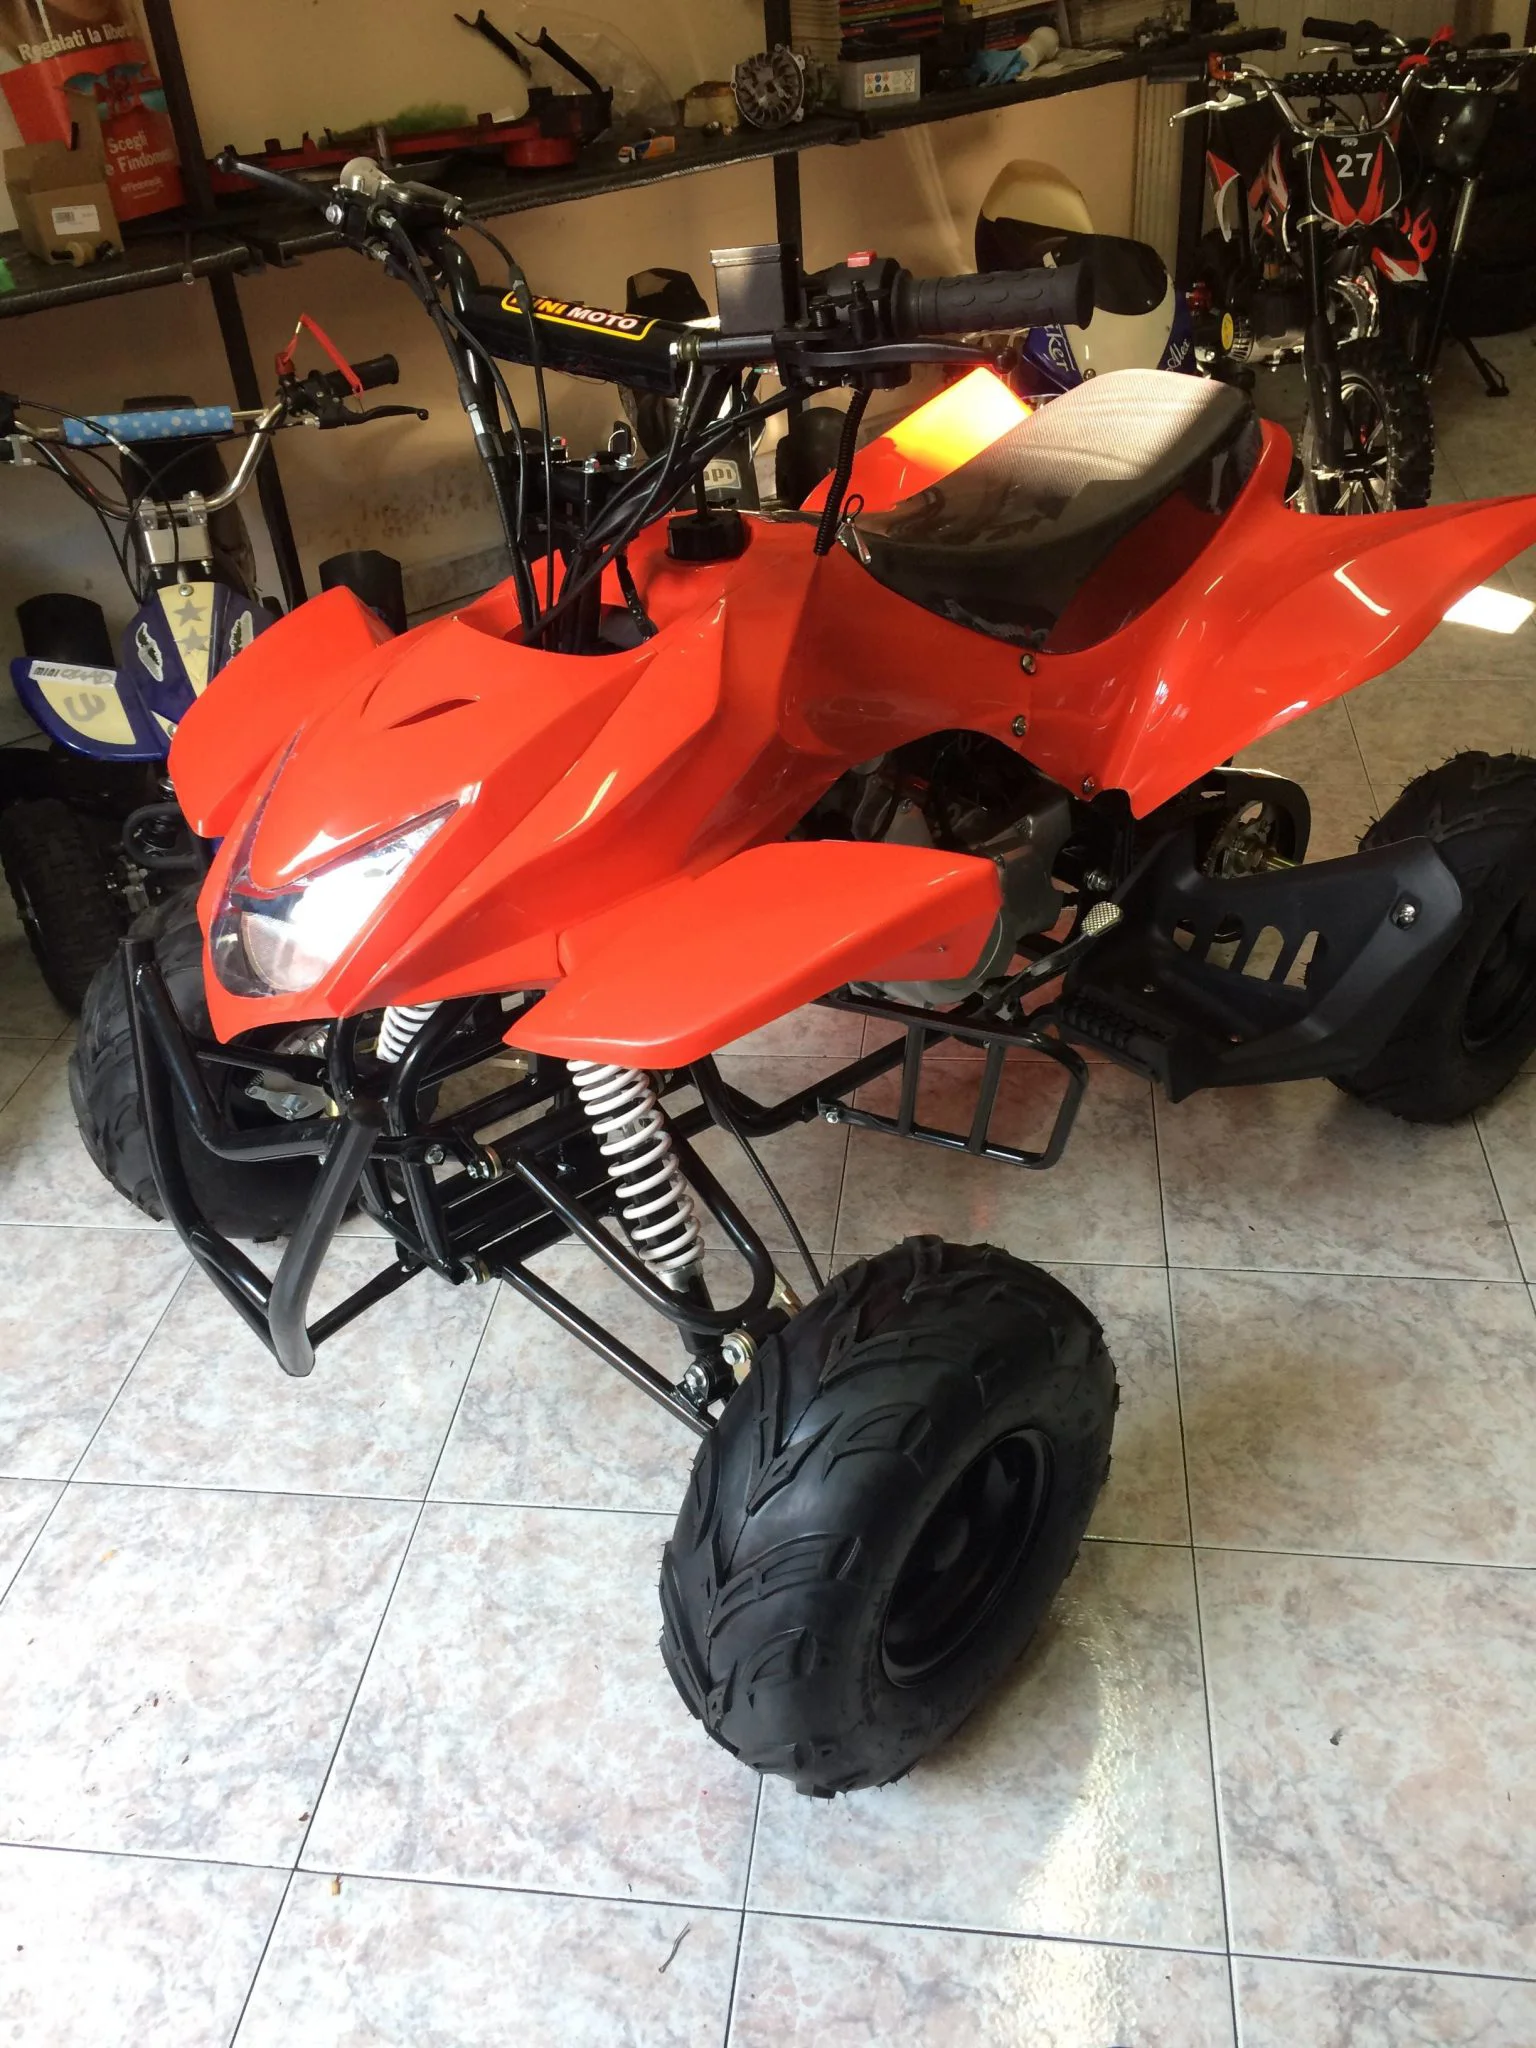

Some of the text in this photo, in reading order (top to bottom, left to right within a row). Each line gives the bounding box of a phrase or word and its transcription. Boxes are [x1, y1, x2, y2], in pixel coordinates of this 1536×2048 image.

[18, 30, 86, 61] Regalati
[87, 27, 103, 44] la
[107, 131, 149, 155] Scegli
[1335, 152, 1374, 178] 27
[510, 296, 638, 330] INI MOTO
